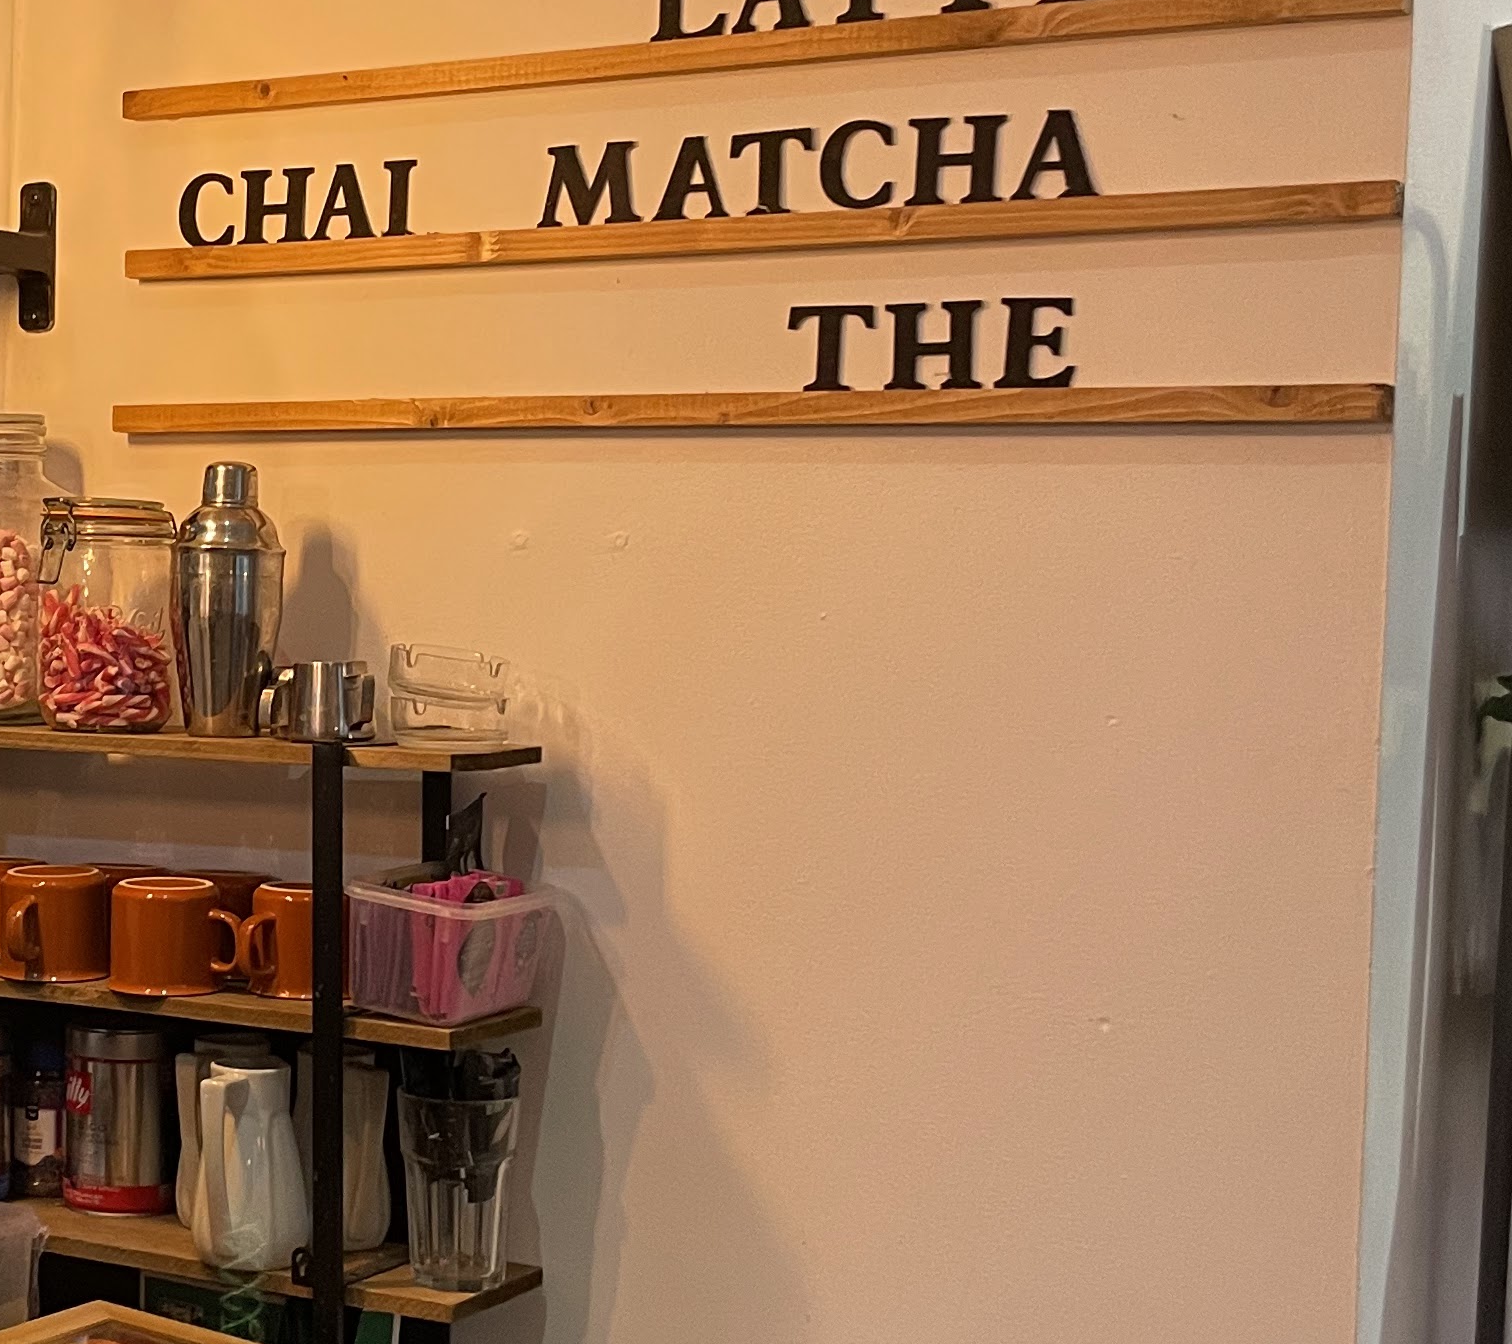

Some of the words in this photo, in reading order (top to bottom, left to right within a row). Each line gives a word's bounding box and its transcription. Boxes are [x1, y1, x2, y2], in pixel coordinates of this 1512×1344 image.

[177, 158, 419, 248] CHAI
[535, 108, 1101, 230] MATCHA
[786, 296, 1077, 393] THE
[66, 1076, 90, 1109] illy
